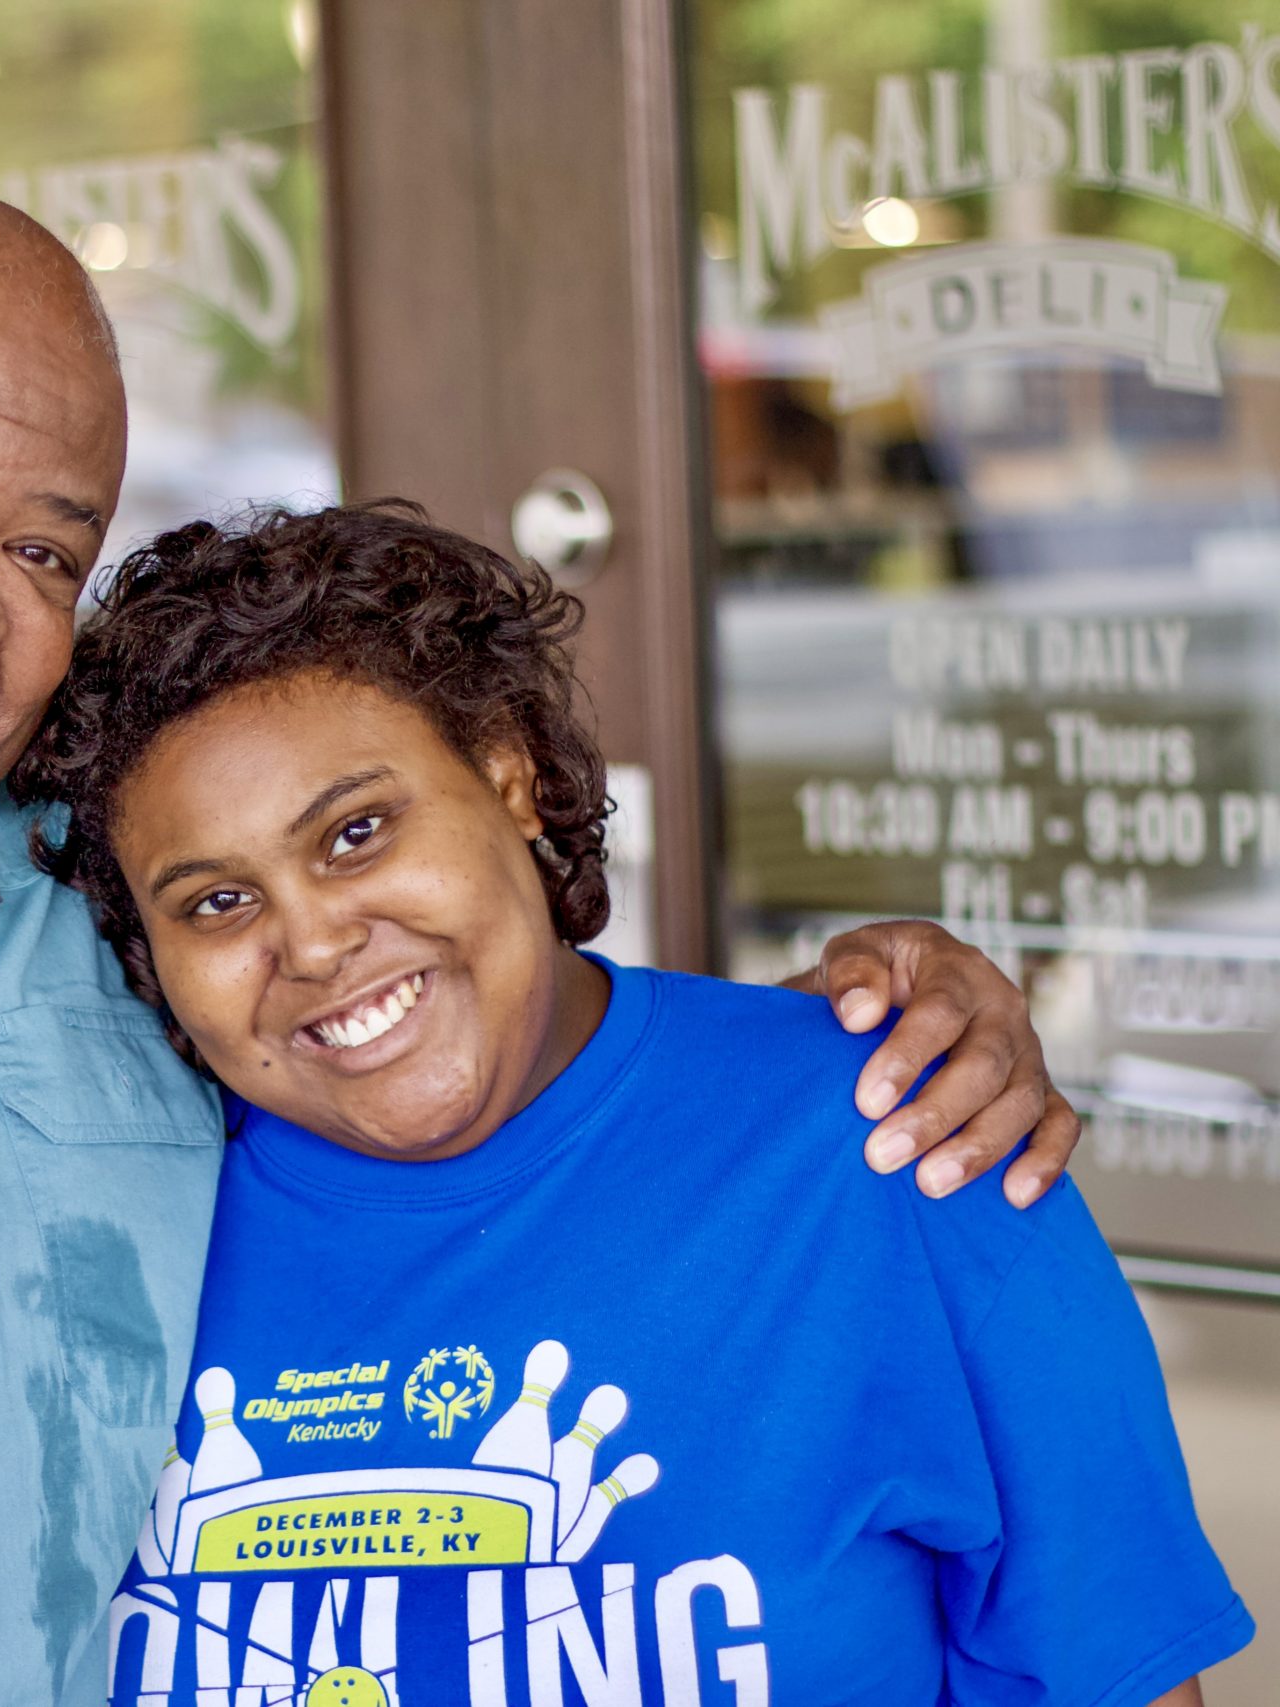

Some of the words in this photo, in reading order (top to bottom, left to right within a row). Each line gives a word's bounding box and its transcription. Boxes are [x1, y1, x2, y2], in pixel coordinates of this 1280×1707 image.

[928, 270, 1108, 334] DELI
[889, 615, 1024, 692] OPEN
[1039, 617, 1190, 692] DAILY
[892, 709, 1004, 778] Mon
[1047, 710, 1196, 786] Thurs
[795, 778, 939, 857] 10:30
[947, 783, 1033, 860] AM
[1083, 788, 1207, 865] 9:00
[275, 1360, 390, 1394] Special
[243, 1391, 385, 1422] Olympics
[287, 1417, 382, 1443] Kentucky
[256, 1509, 402, 1531] DECEMBER
[417, 1506, 465, 1524] 2-3
[236, 1534, 426, 1559] LOUISVILLE,
[442, 1532, 482, 1552] KY
